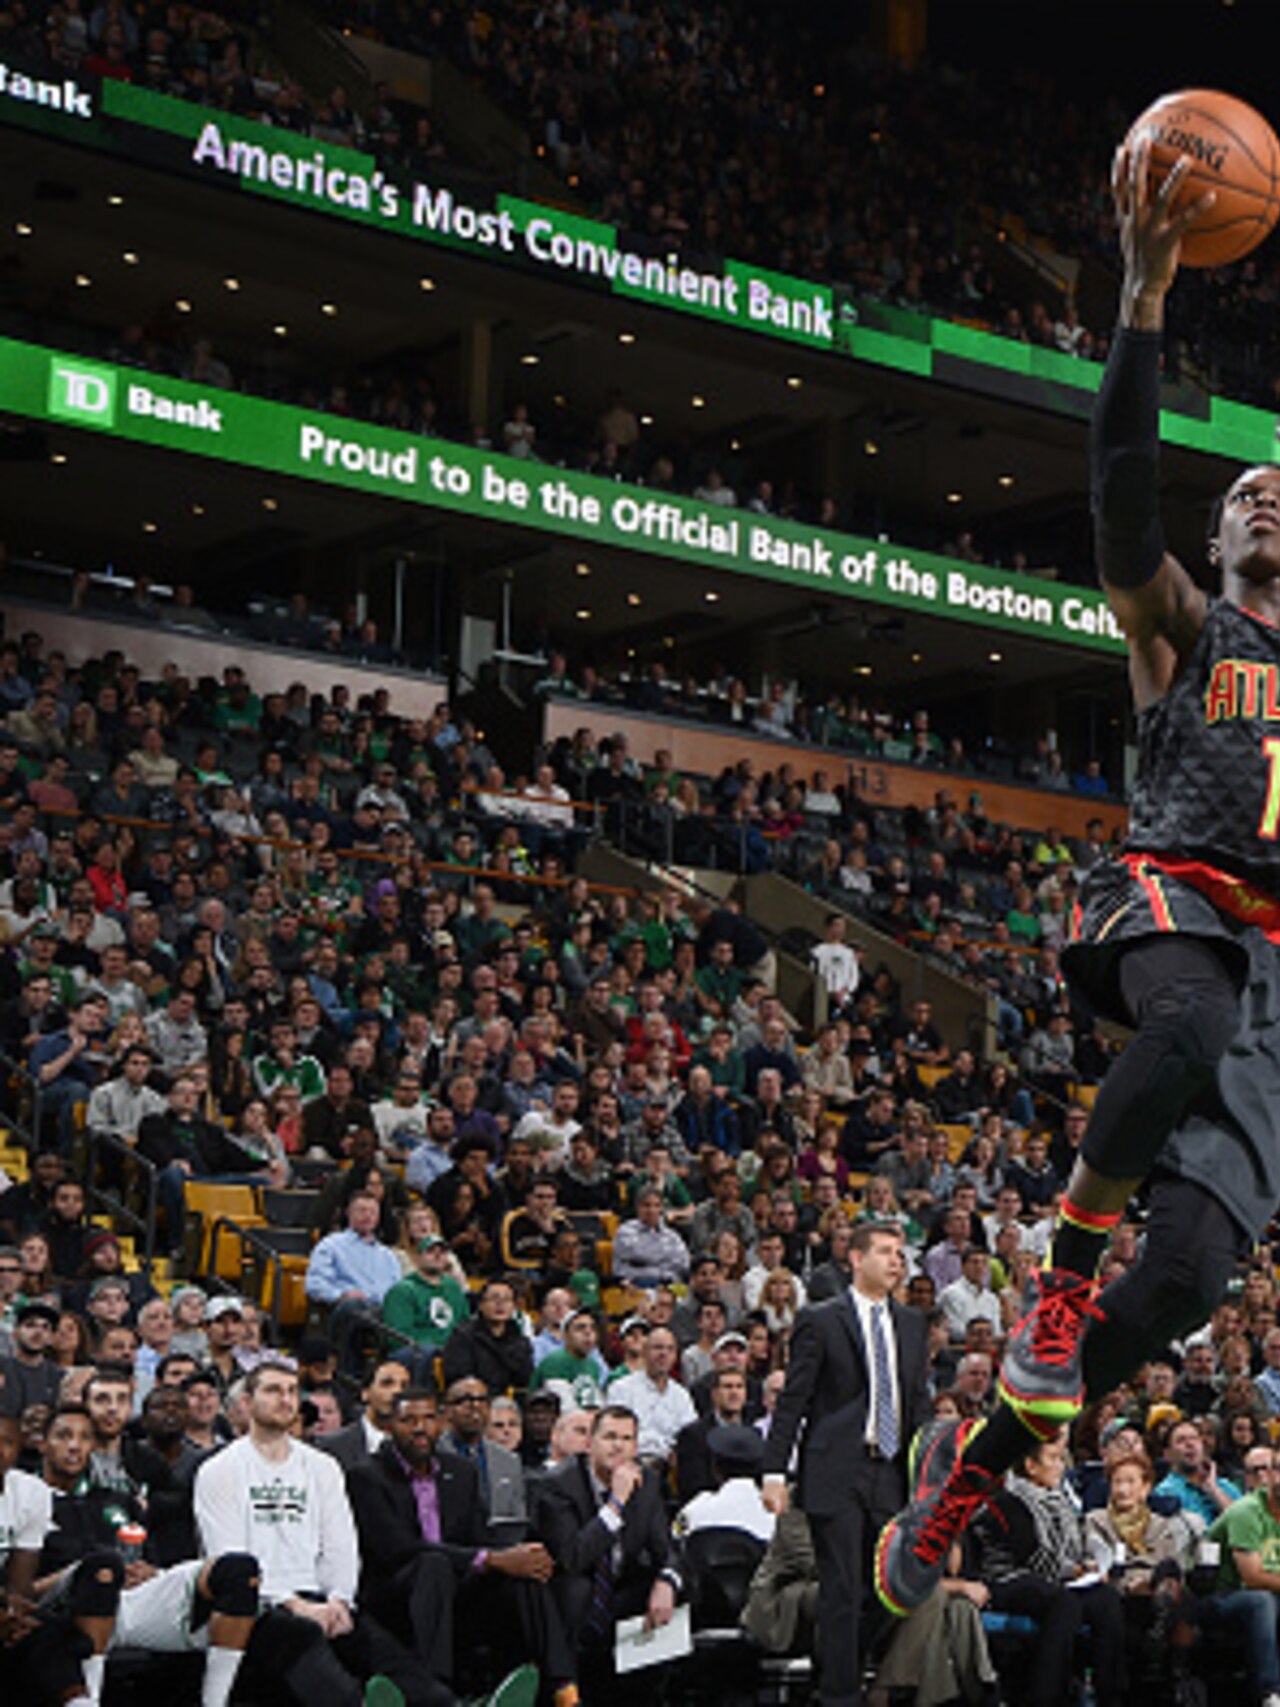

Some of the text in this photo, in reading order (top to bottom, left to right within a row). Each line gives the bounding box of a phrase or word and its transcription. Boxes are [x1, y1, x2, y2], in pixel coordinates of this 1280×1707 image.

[193, 123, 832, 340] America's Most Convenient Bank
[56, 369, 222, 431] TD Bank
[300, 424, 416, 484] Proud
[429, 457, 470, 494] to
[482, 465, 529, 508] be
[540, 481, 600, 524] the
[611, 497, 739, 556] Official
[749, 526, 833, 577] Bank
[840, 551, 877, 585] of
[885, 559, 938, 599] the
[947, 572, 1053, 625] Boston
